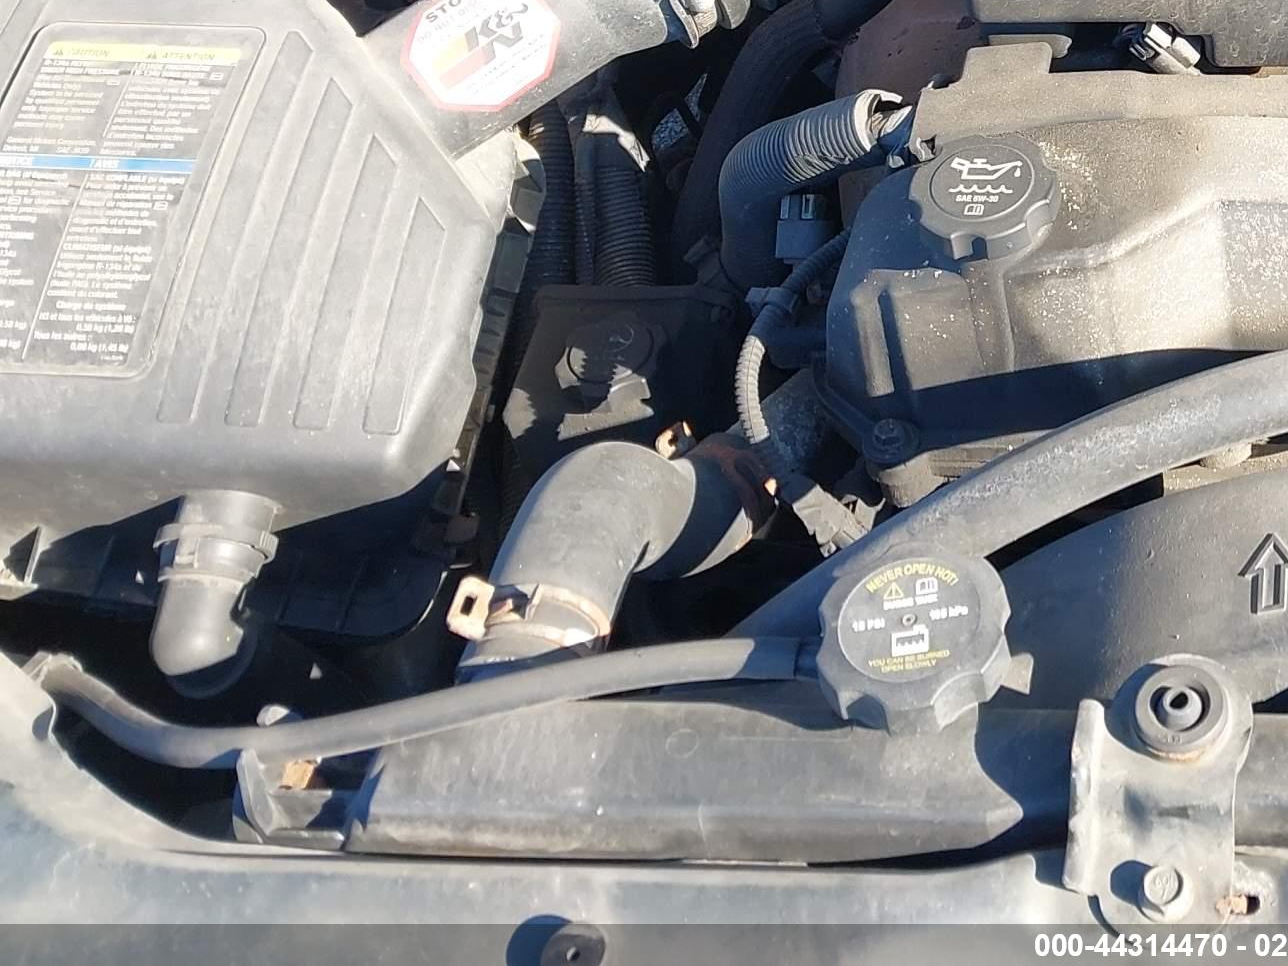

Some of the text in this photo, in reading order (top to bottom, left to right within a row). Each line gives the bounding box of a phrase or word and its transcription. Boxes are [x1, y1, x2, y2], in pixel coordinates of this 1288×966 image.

[955, 194, 999, 202] SAE 5W-30
[866, 563, 960, 593] NEVER OPEN HOT!
[867, 618, 886, 631] PSI
[948, 605, 969, 618] kPa
[868, 658, 886, 668] YOU
